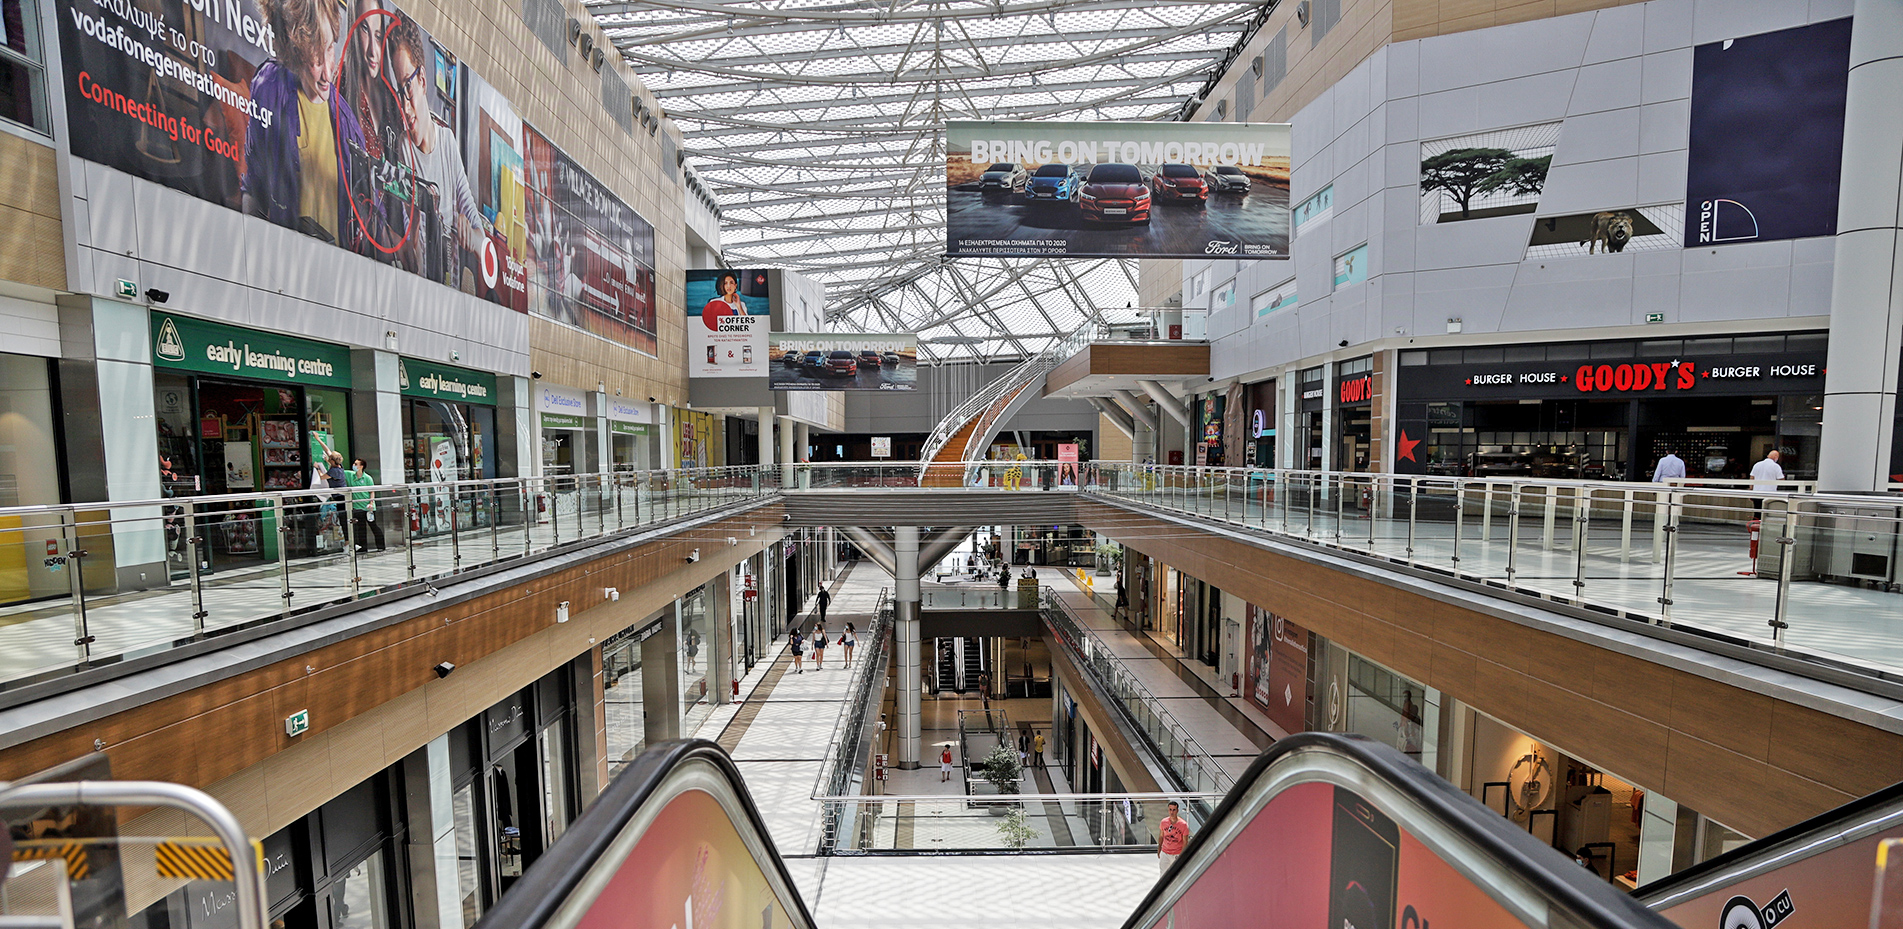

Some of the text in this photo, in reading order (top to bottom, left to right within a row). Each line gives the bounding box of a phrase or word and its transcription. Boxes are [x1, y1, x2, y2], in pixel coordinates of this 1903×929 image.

[169, 27, 187, 52] το
[190, 40, 216, 67] στο
[70, 7, 273, 129] vodafonegenerationnext.gr
[78, 71, 239, 162] Connecting for Good
[971, 140, 1265, 166] BRING ON TOMORROW
[1700, 200, 1712, 243] OPEN
[1205, 240, 1238, 254] Ford
[502, 271, 525, 293] Vodafone
[206, 340, 333, 378] early learning centre
[779, 340, 906, 352] BRING ON TOMORROW
[1473, 372, 1556, 385] BURGER HOUSE
[1575, 360, 1695, 392] GOODY'S
[1712, 364, 1816, 378] BURGER HOUSE
[419, 372, 487, 398] early learning centre
[1341, 375, 1372, 403] GOODY'S
[1777, 896, 1790, 913] CU
